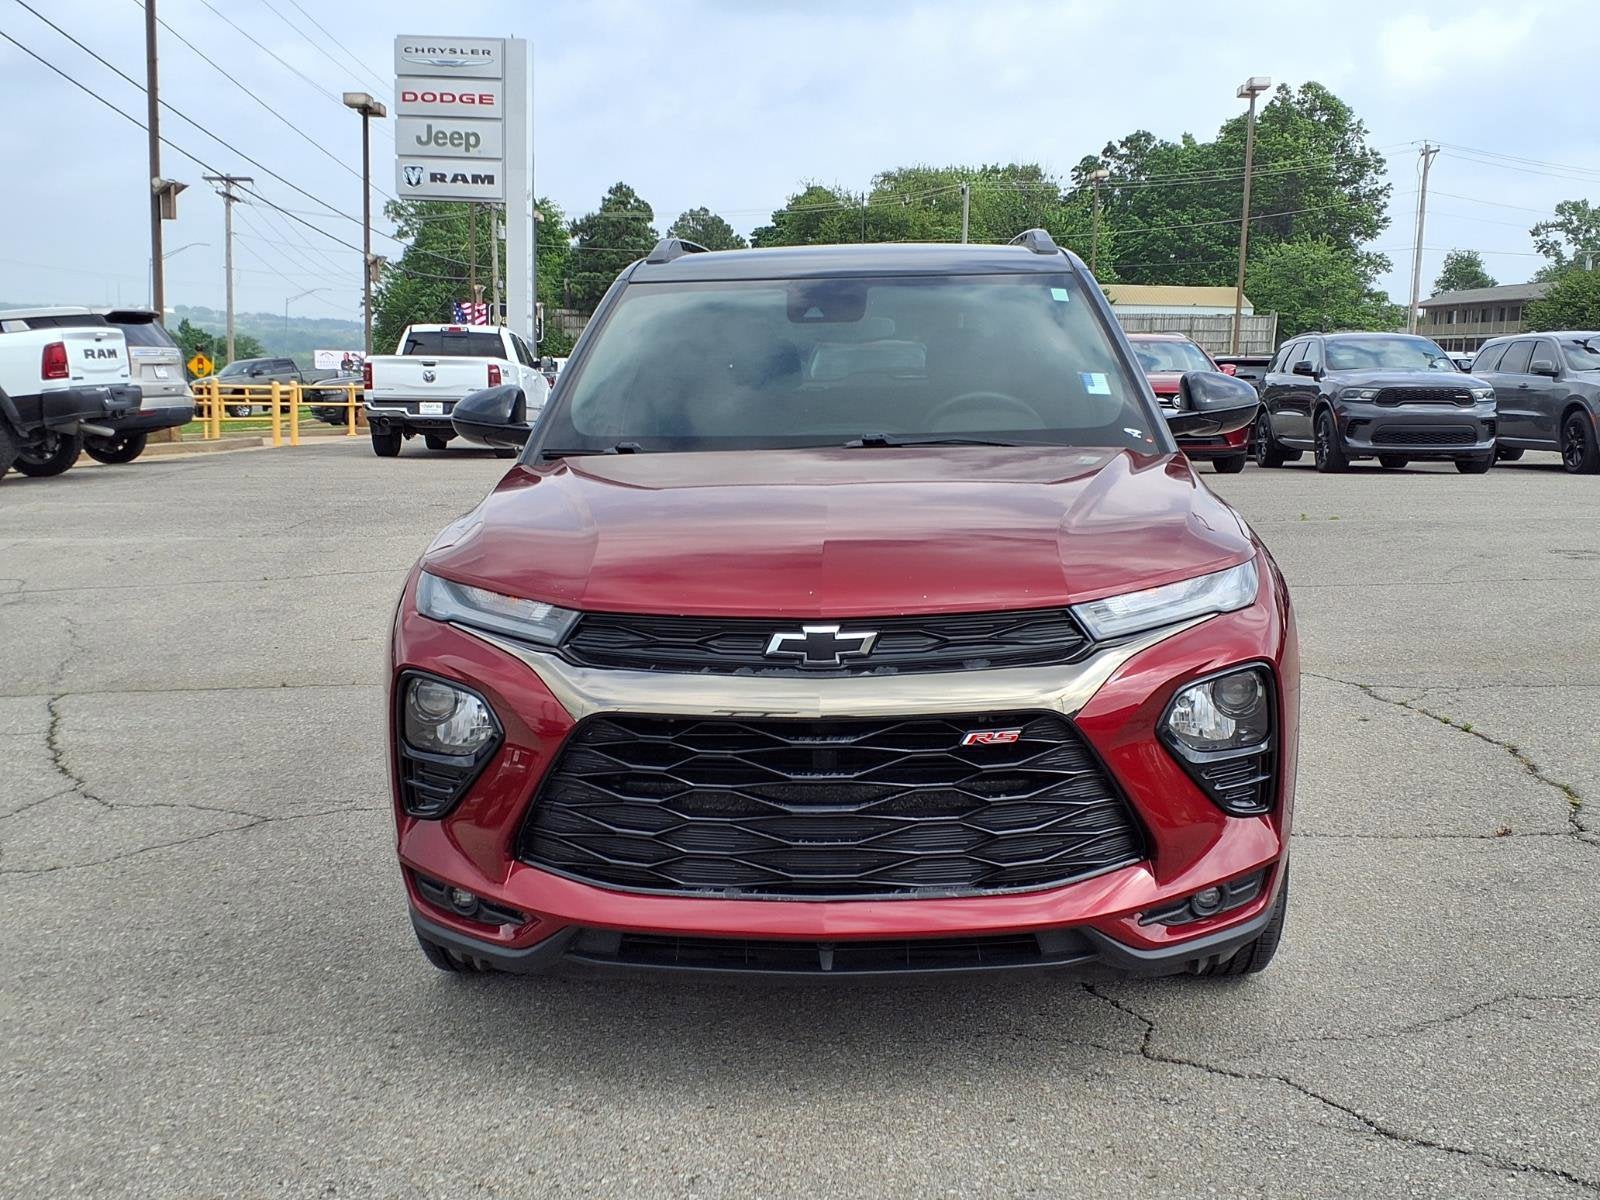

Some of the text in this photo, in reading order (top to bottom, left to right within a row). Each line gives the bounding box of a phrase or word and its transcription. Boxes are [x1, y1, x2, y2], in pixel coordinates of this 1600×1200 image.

[404, 46, 492, 56] CHRYSLER
[402, 91, 494, 105] DODGE
[416, 124, 481, 153] Jeep
[429, 172, 495, 185] RAM
[84, 348, 118, 359] RAM
[962, 730, 1021, 746] RS
